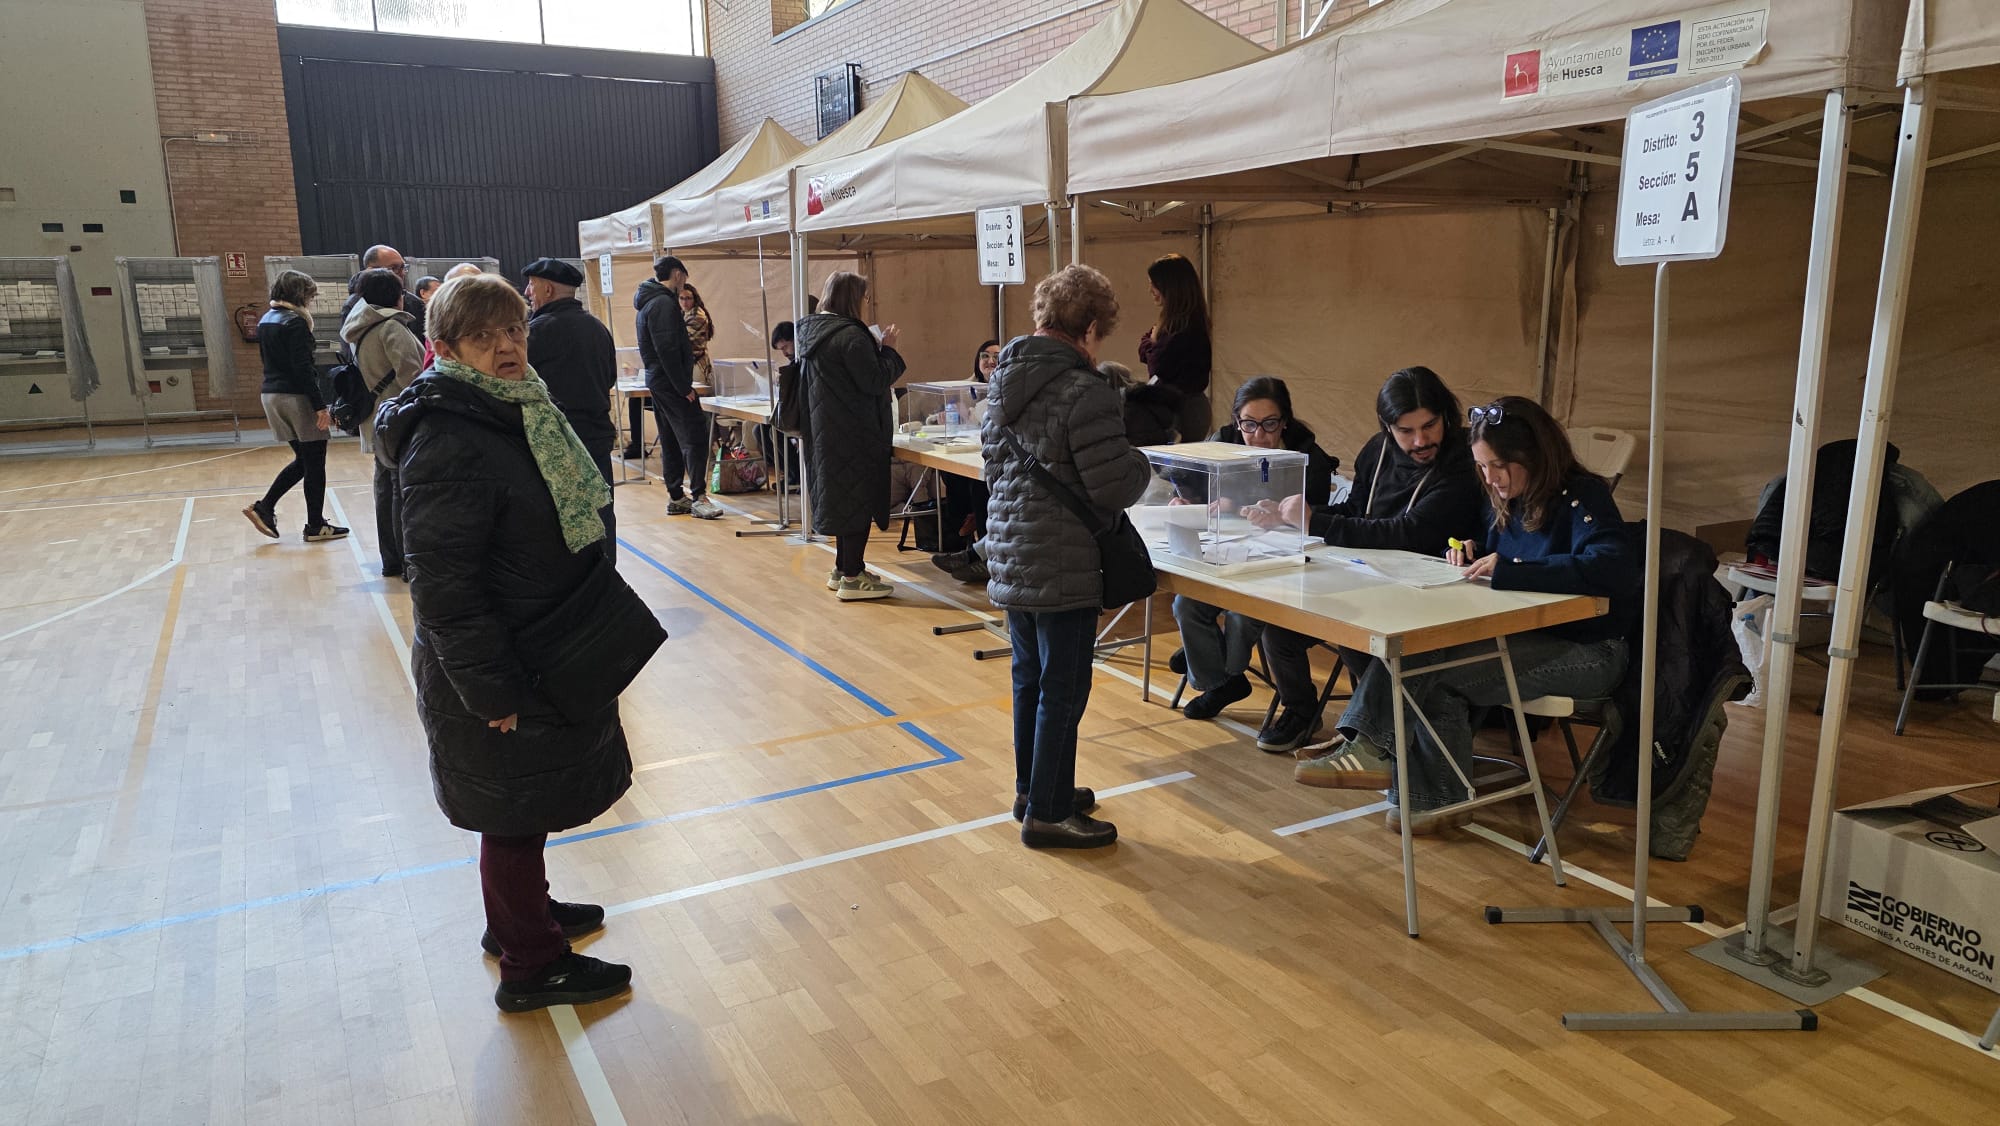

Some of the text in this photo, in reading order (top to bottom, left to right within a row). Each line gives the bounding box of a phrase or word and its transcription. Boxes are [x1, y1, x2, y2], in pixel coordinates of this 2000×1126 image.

[1546, 46, 1623, 69] Ayuntamiento
[1546, 65, 1603, 83] de Huesca
[1643, 111, 1704, 153] Distrito: 3
[1639, 152, 1700, 190] Sección: 5
[831, 186, 856, 200] Huesca
[1007, 215, 1012, 229] 3
[1636, 192, 1699, 227] Mesa: A
[1007, 233, 1013, 248] 4
[1008, 253, 1015, 266] B
[1882, 896, 1982, 946] GOBIERNO
[1844, 914, 1993, 983] ELECCIONES A CORTES DE ARAGÓN
[1880, 911, 1994, 970] DE ARAGON
